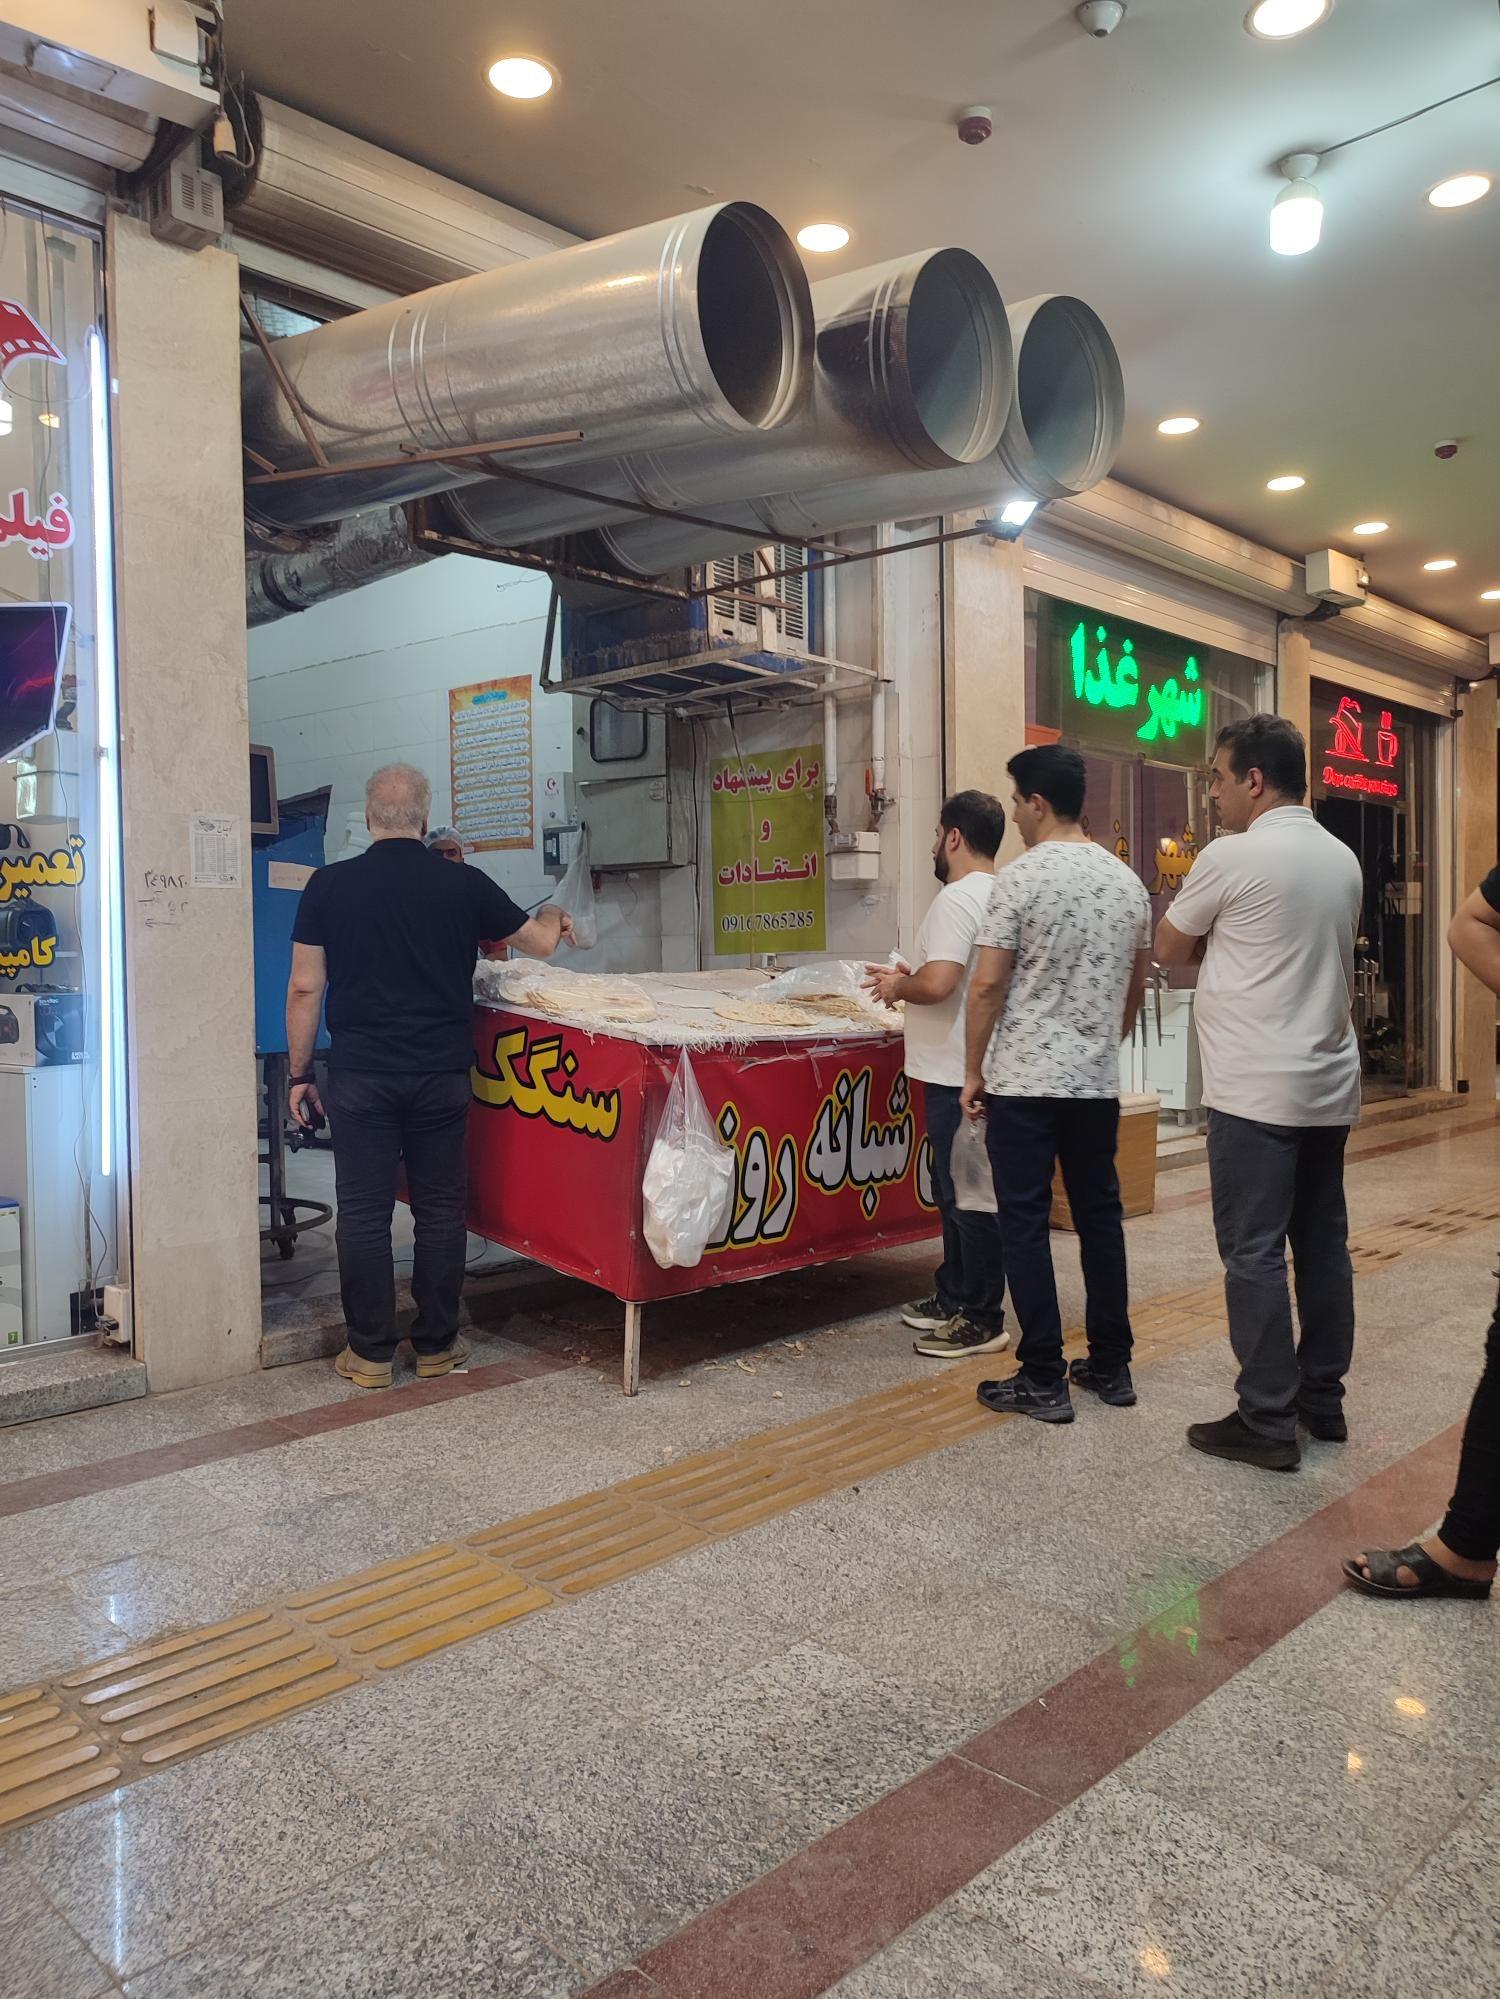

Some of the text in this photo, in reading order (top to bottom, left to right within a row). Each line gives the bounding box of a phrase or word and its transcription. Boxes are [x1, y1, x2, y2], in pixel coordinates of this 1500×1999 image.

[1070, 622, 1202, 740] شهر غذا
[712, 757, 820, 795] برای پیشنهاد
[759, 819, 772, 841] و
[718, 852, 818, 886] انتقادات
[470, 1026, 622, 1143] سنگک
[802, 1065, 916, 1220] شبانه
